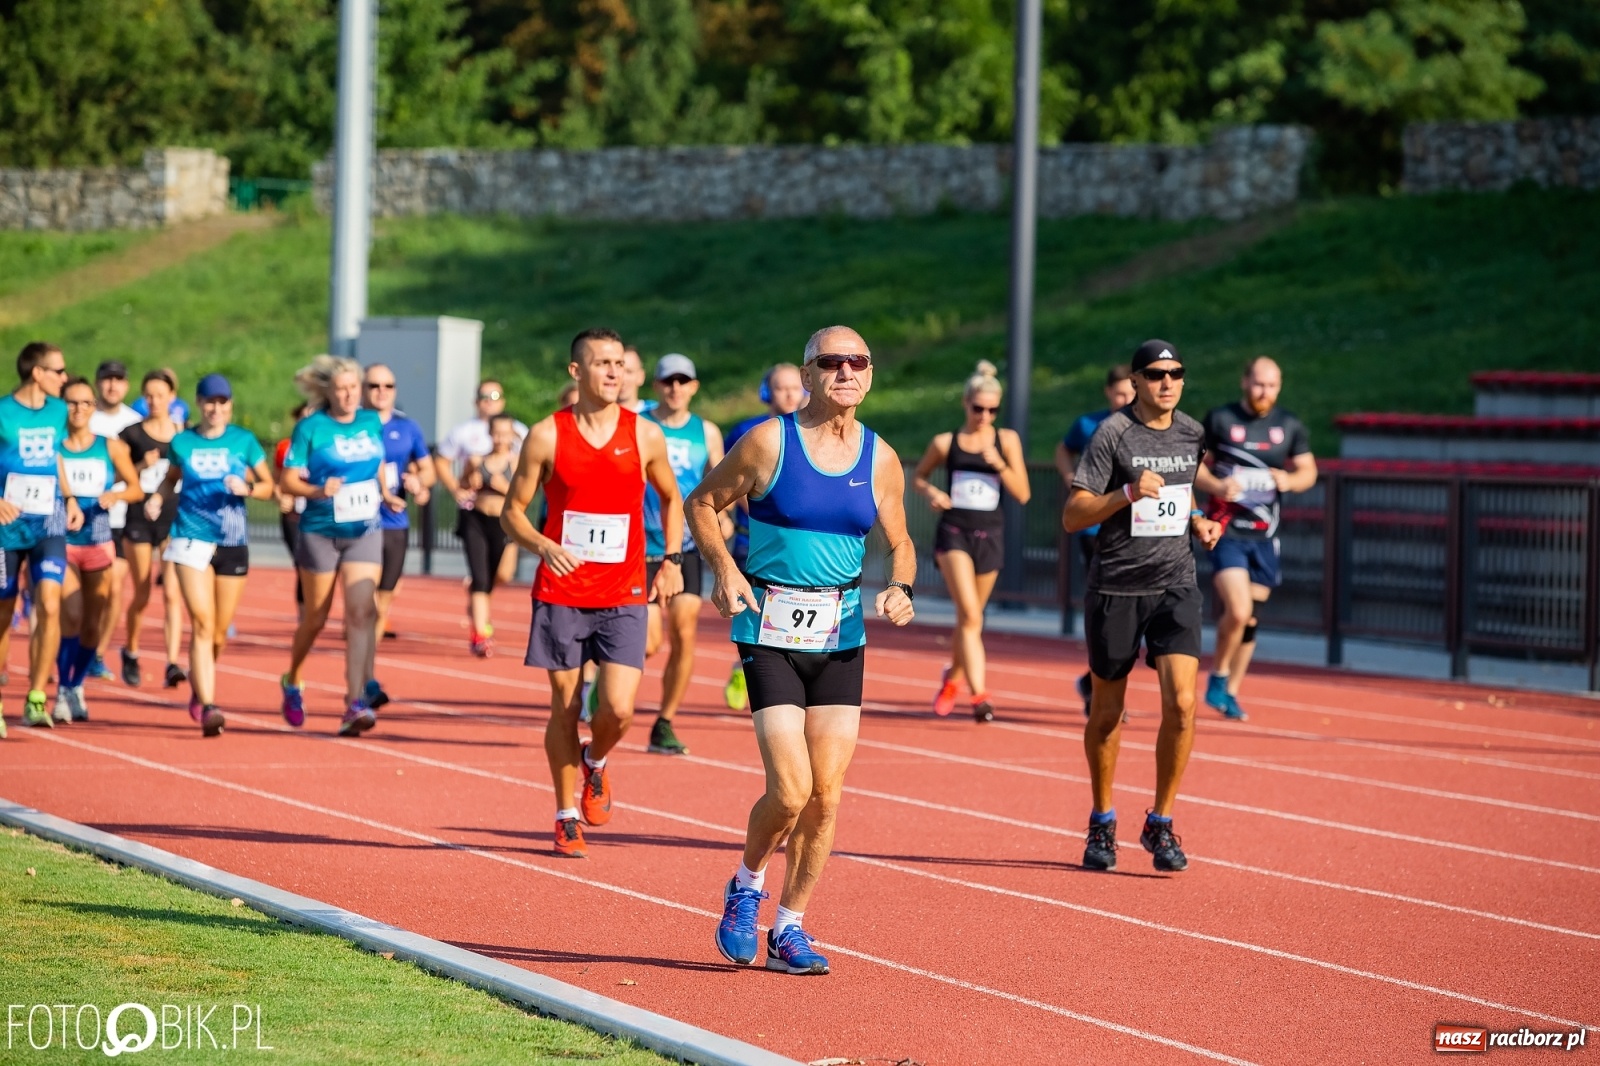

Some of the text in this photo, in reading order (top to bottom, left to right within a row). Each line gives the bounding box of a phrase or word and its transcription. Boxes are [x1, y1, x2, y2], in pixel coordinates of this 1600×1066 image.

[1132, 455, 1197, 467] PITBULL
[1150, 465, 1187, 473] SPORTS
[73, 471, 93, 481] 101
[1158, 501, 1176, 517] 50
[589, 529, 605, 544] 11
[791, 608, 817, 628] 97
